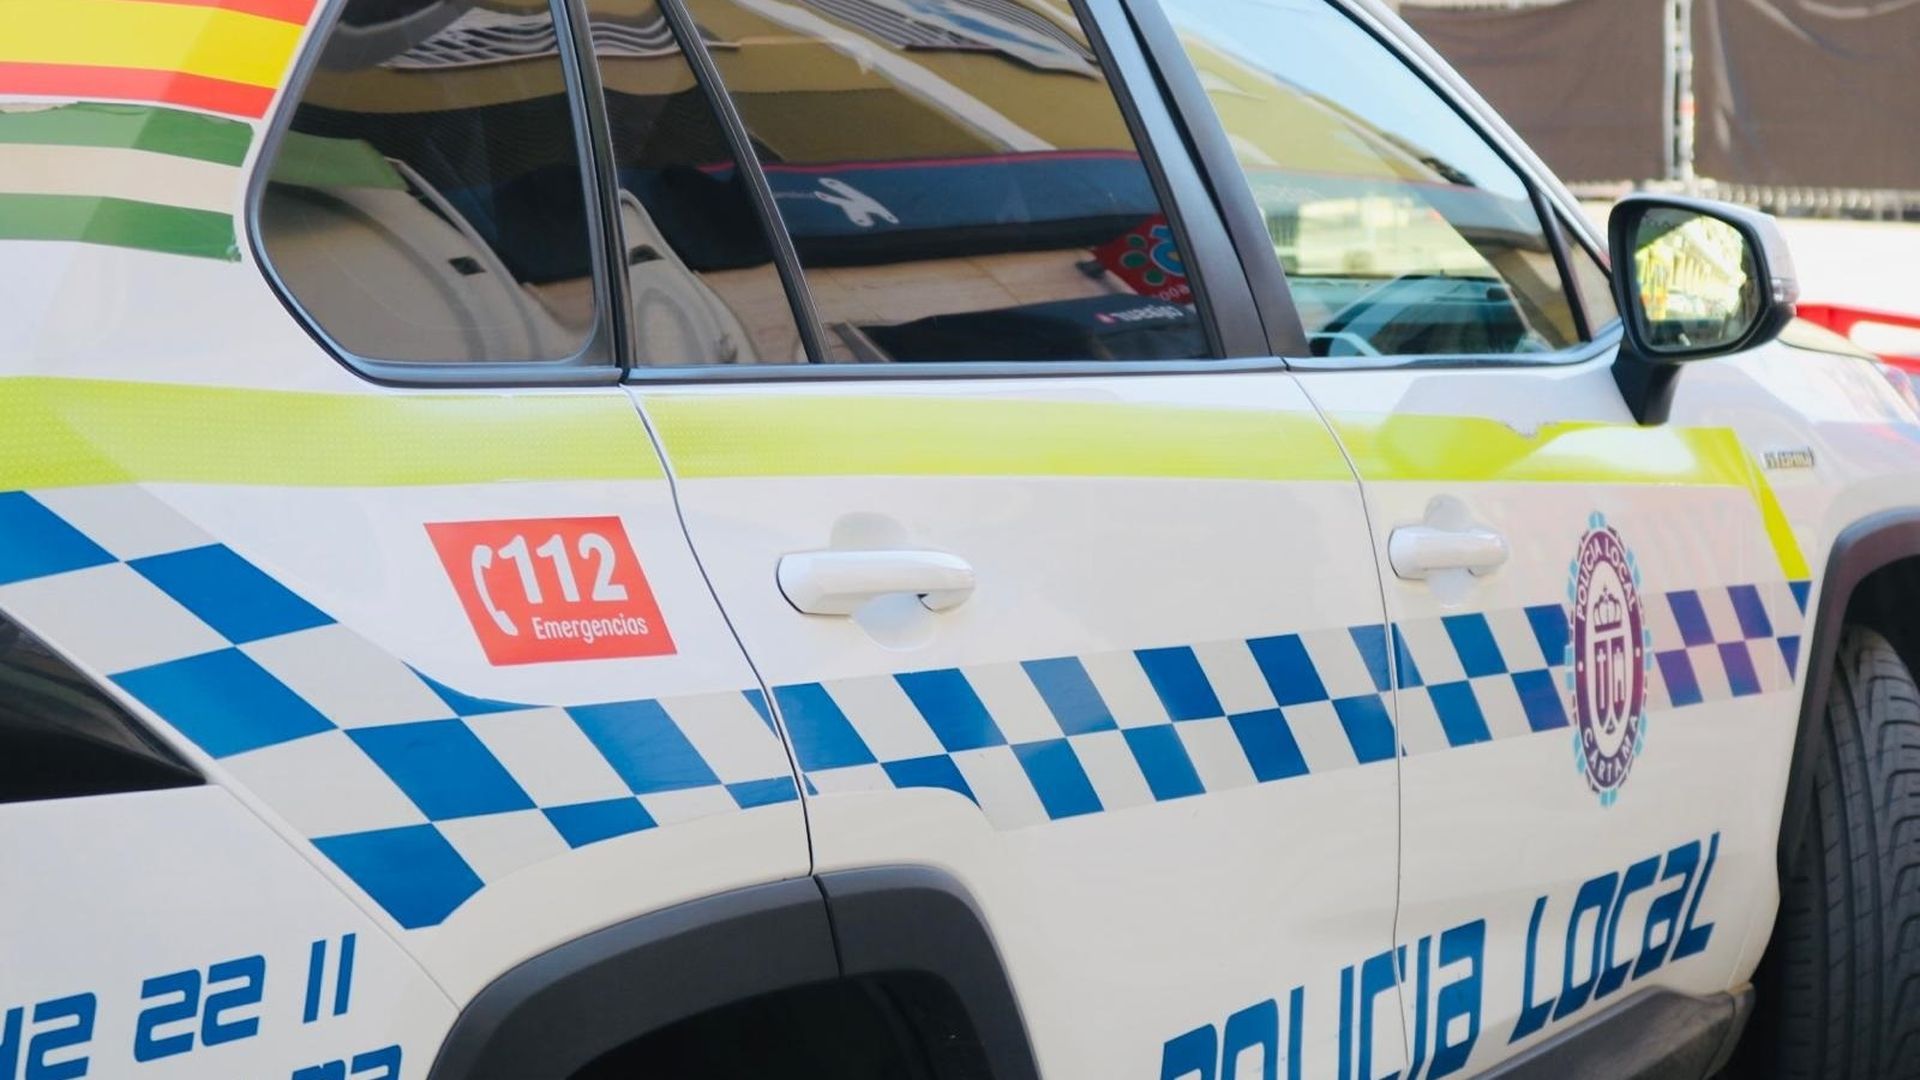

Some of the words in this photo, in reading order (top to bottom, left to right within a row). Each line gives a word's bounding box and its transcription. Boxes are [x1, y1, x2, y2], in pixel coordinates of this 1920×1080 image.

[498, 533, 628, 604] 112
[1576, 538, 1603, 621] POLICIA
[1604, 538, 1636, 612] LOCAL
[531, 614, 649, 644] Emergencias
[1584, 716, 1638, 782] CARTAMA
[1160, 918, 1486, 1080] ICIA
[1507, 831, 1720, 1045] LOCAL
[134, 955, 266, 1063] 22
